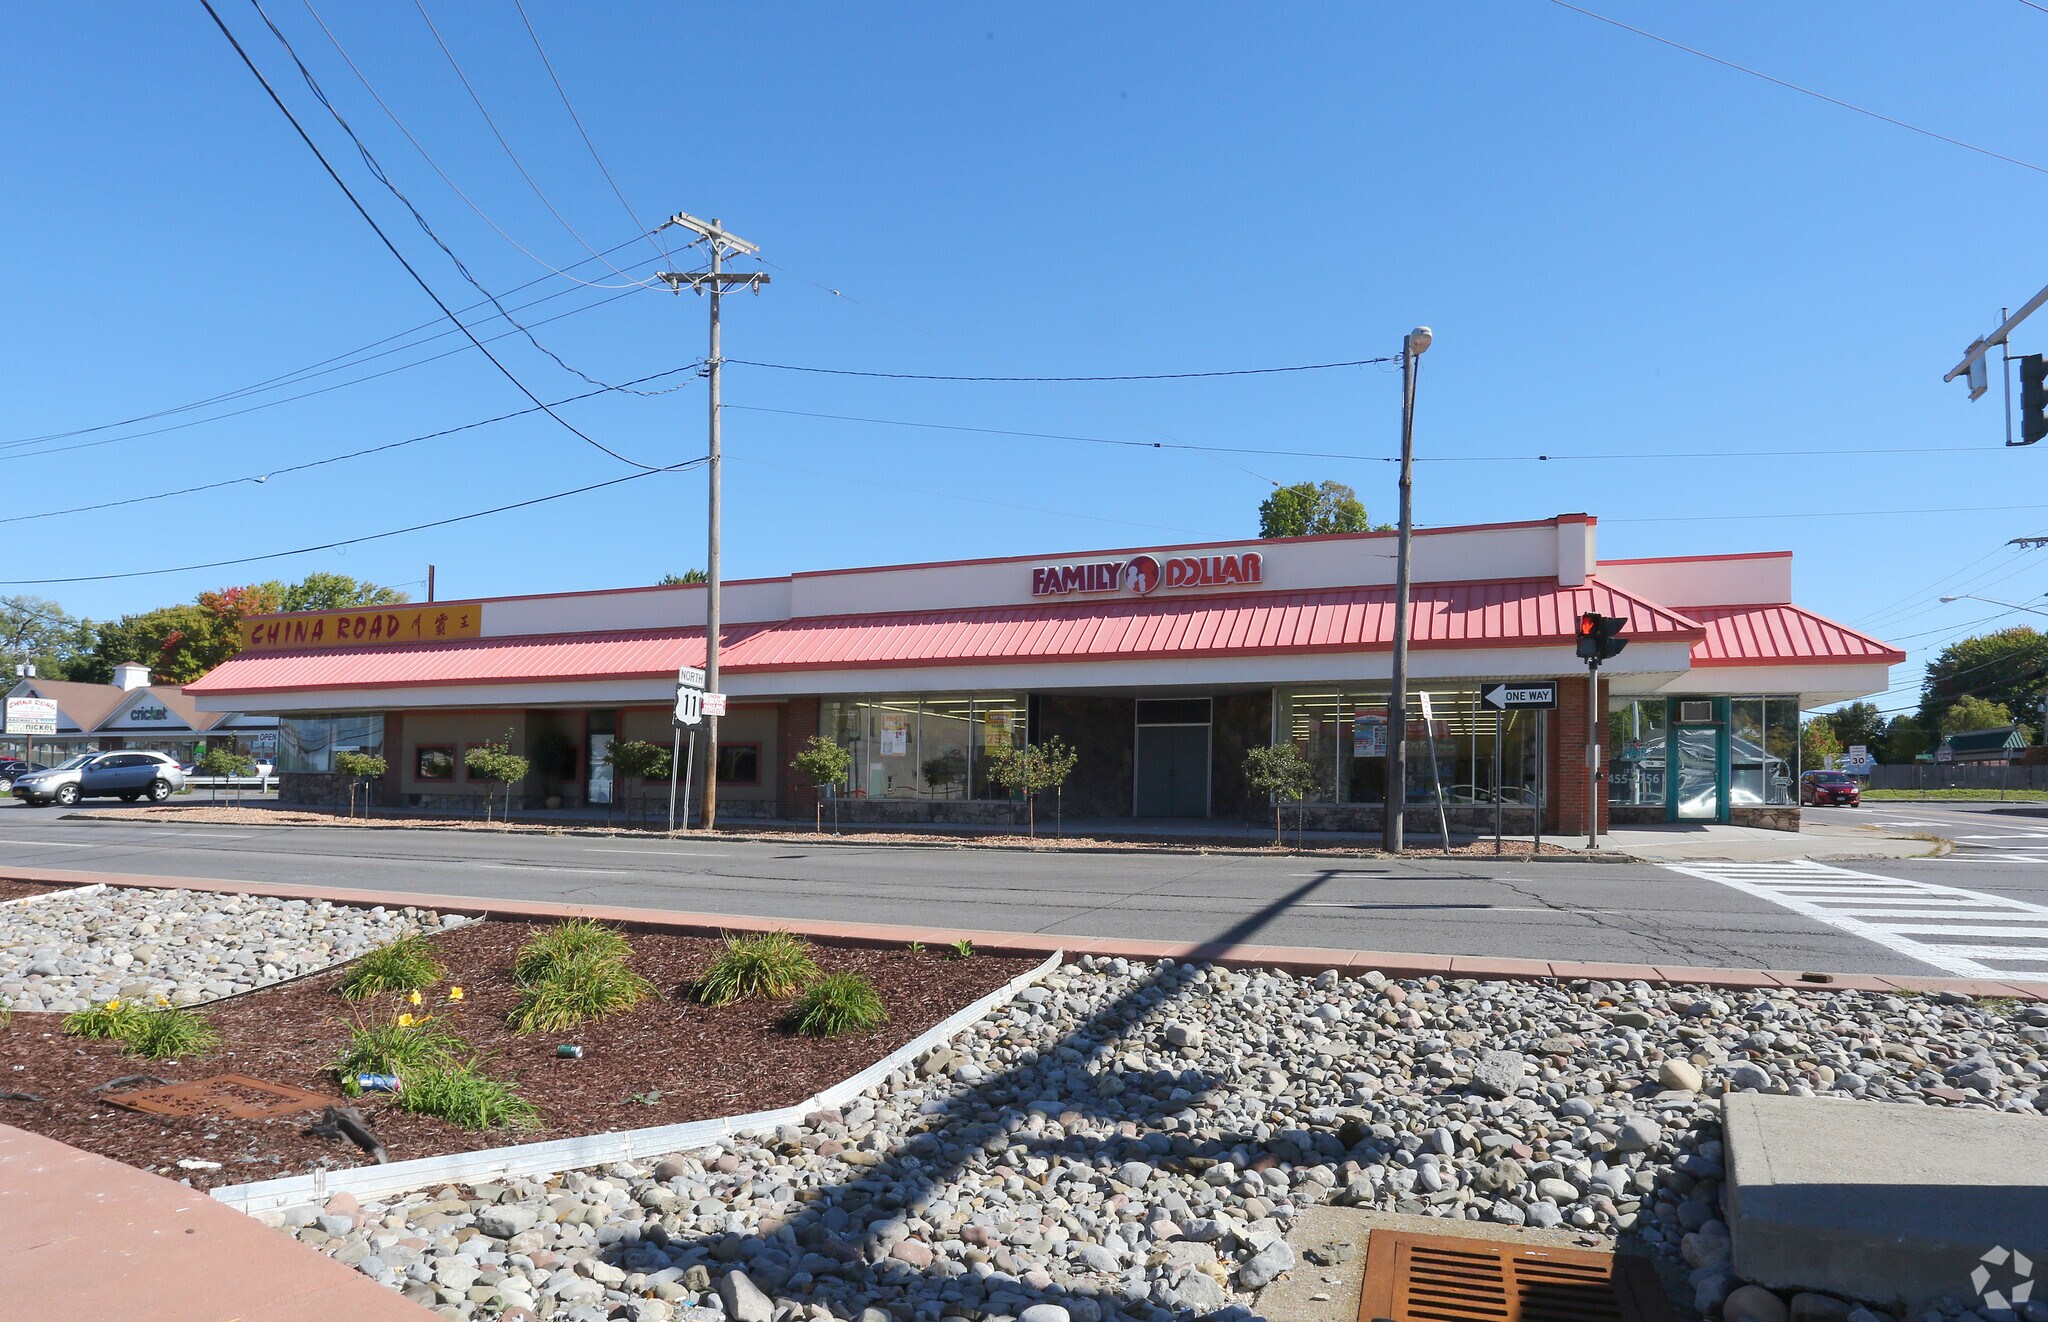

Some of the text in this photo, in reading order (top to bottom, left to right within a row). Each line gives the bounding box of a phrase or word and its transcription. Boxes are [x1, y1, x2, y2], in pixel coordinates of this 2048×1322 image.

[1032, 552, 1263, 595] FAMILY DOLLAR
[251, 614, 400, 645] CHINA ROAD
[681, 669, 703, 684] NORTH
[1506, 691, 1549, 701] ONE WAY
[9, 700, 32, 708] CHINA
[684, 694, 697, 717] 11
[130, 706, 167, 720] cricket
[260, 733, 277, 741] OPEN
[1852, 757, 1864, 765] 30
